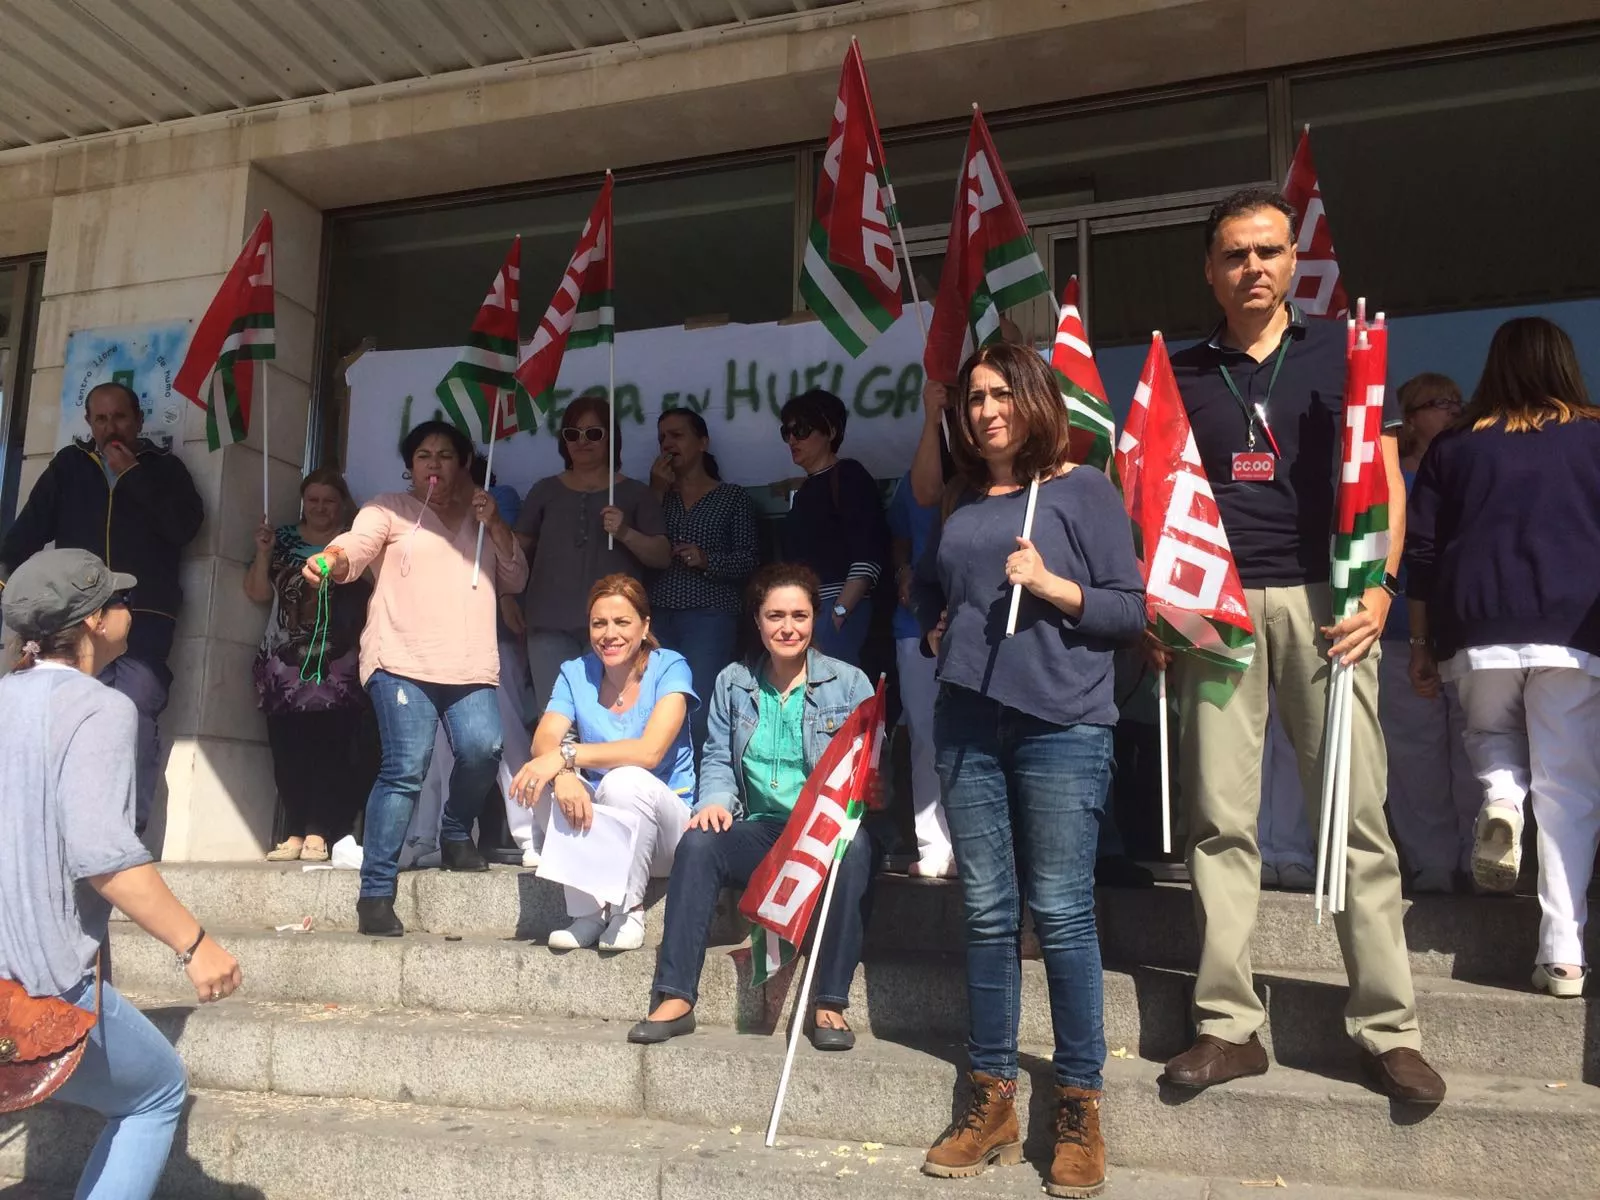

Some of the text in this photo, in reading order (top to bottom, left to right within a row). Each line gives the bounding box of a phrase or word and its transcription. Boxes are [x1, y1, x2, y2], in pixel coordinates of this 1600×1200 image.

[75, 370, 93, 407] Centro
[164, 369, 173, 398] humo
[724, 358, 926, 422] HUELGA
